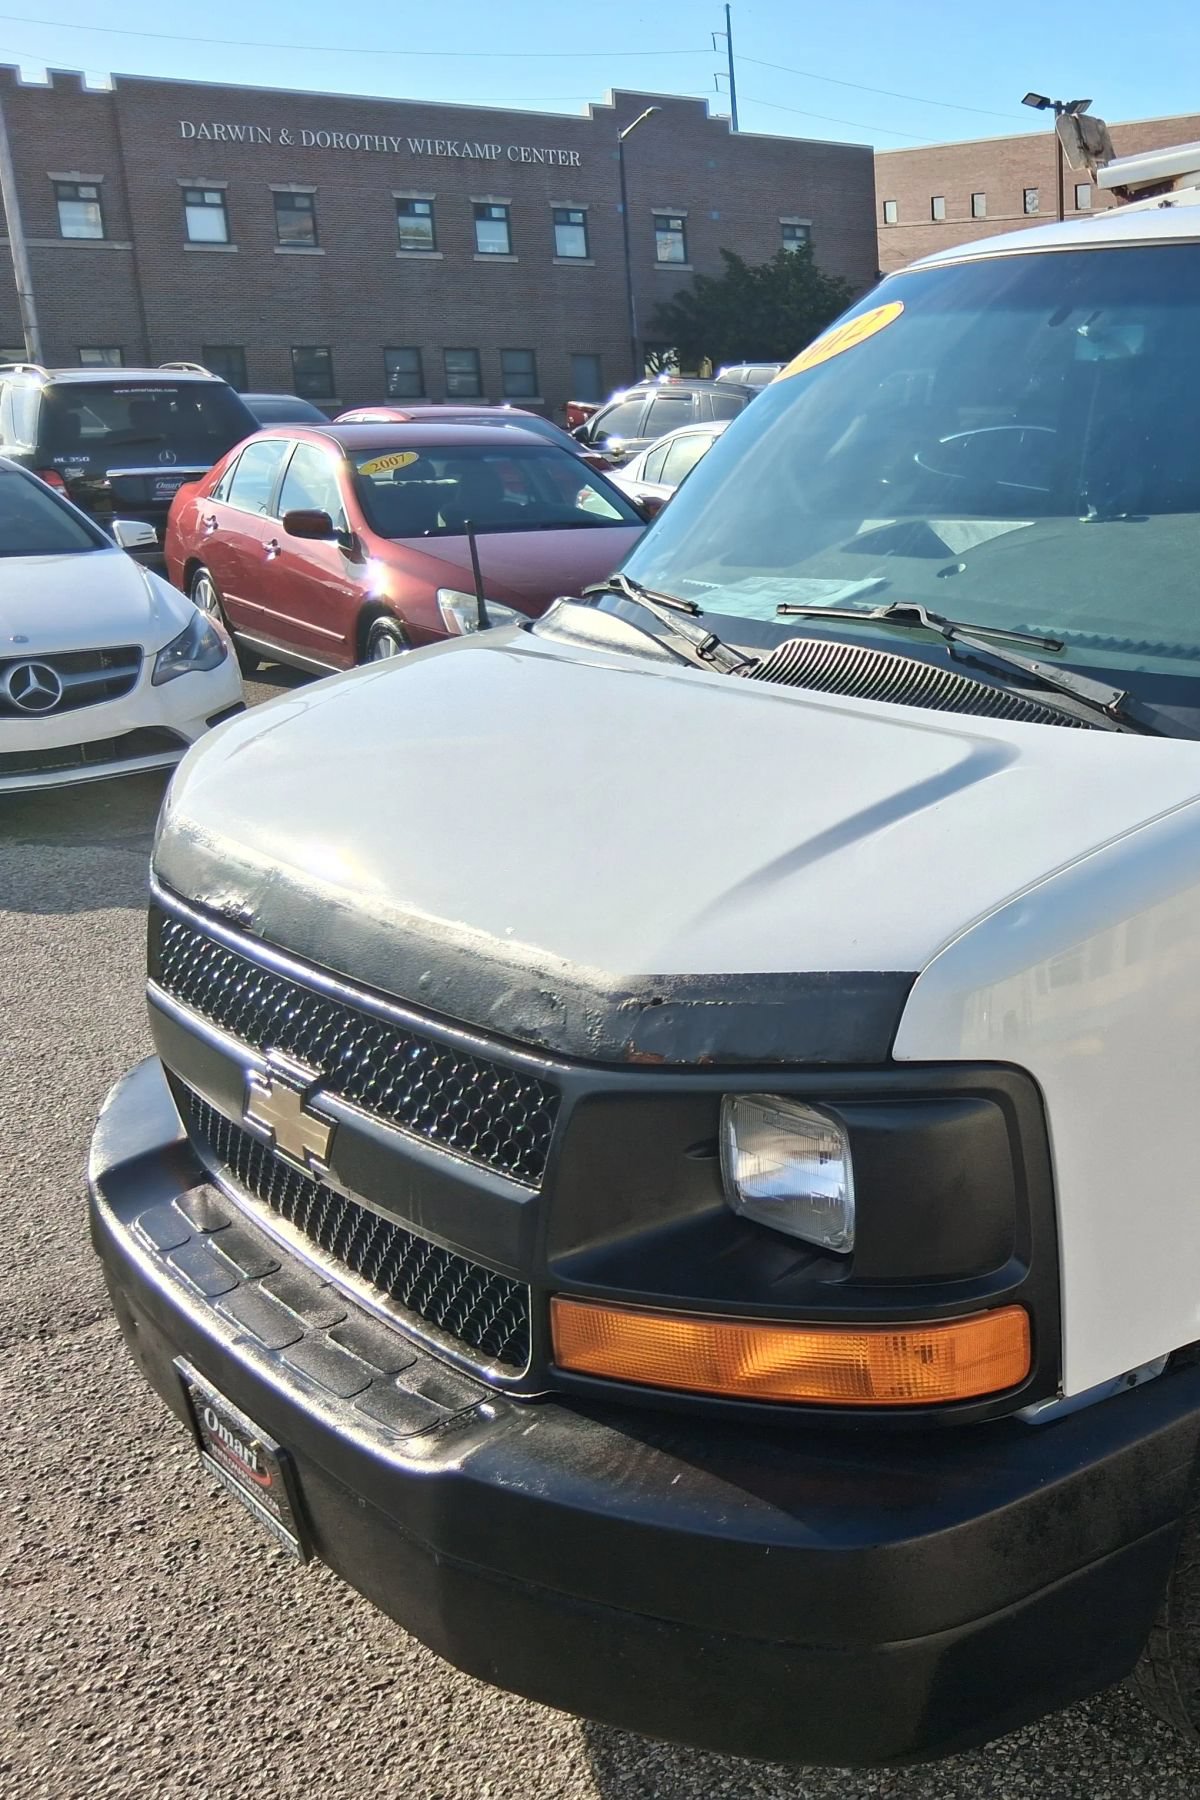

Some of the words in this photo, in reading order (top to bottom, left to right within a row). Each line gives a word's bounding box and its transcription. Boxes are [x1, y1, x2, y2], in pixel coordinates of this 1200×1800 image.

[178, 120, 272, 144] DARWIN
[279, 128, 295, 146] &
[301, 130, 401, 153] DOROTHY
[406, 137, 502, 160] WIEKAMP
[507, 146, 582, 167] CENTER
[371, 454, 405, 472] 2007
[204, 1407, 258, 1470] Omari
